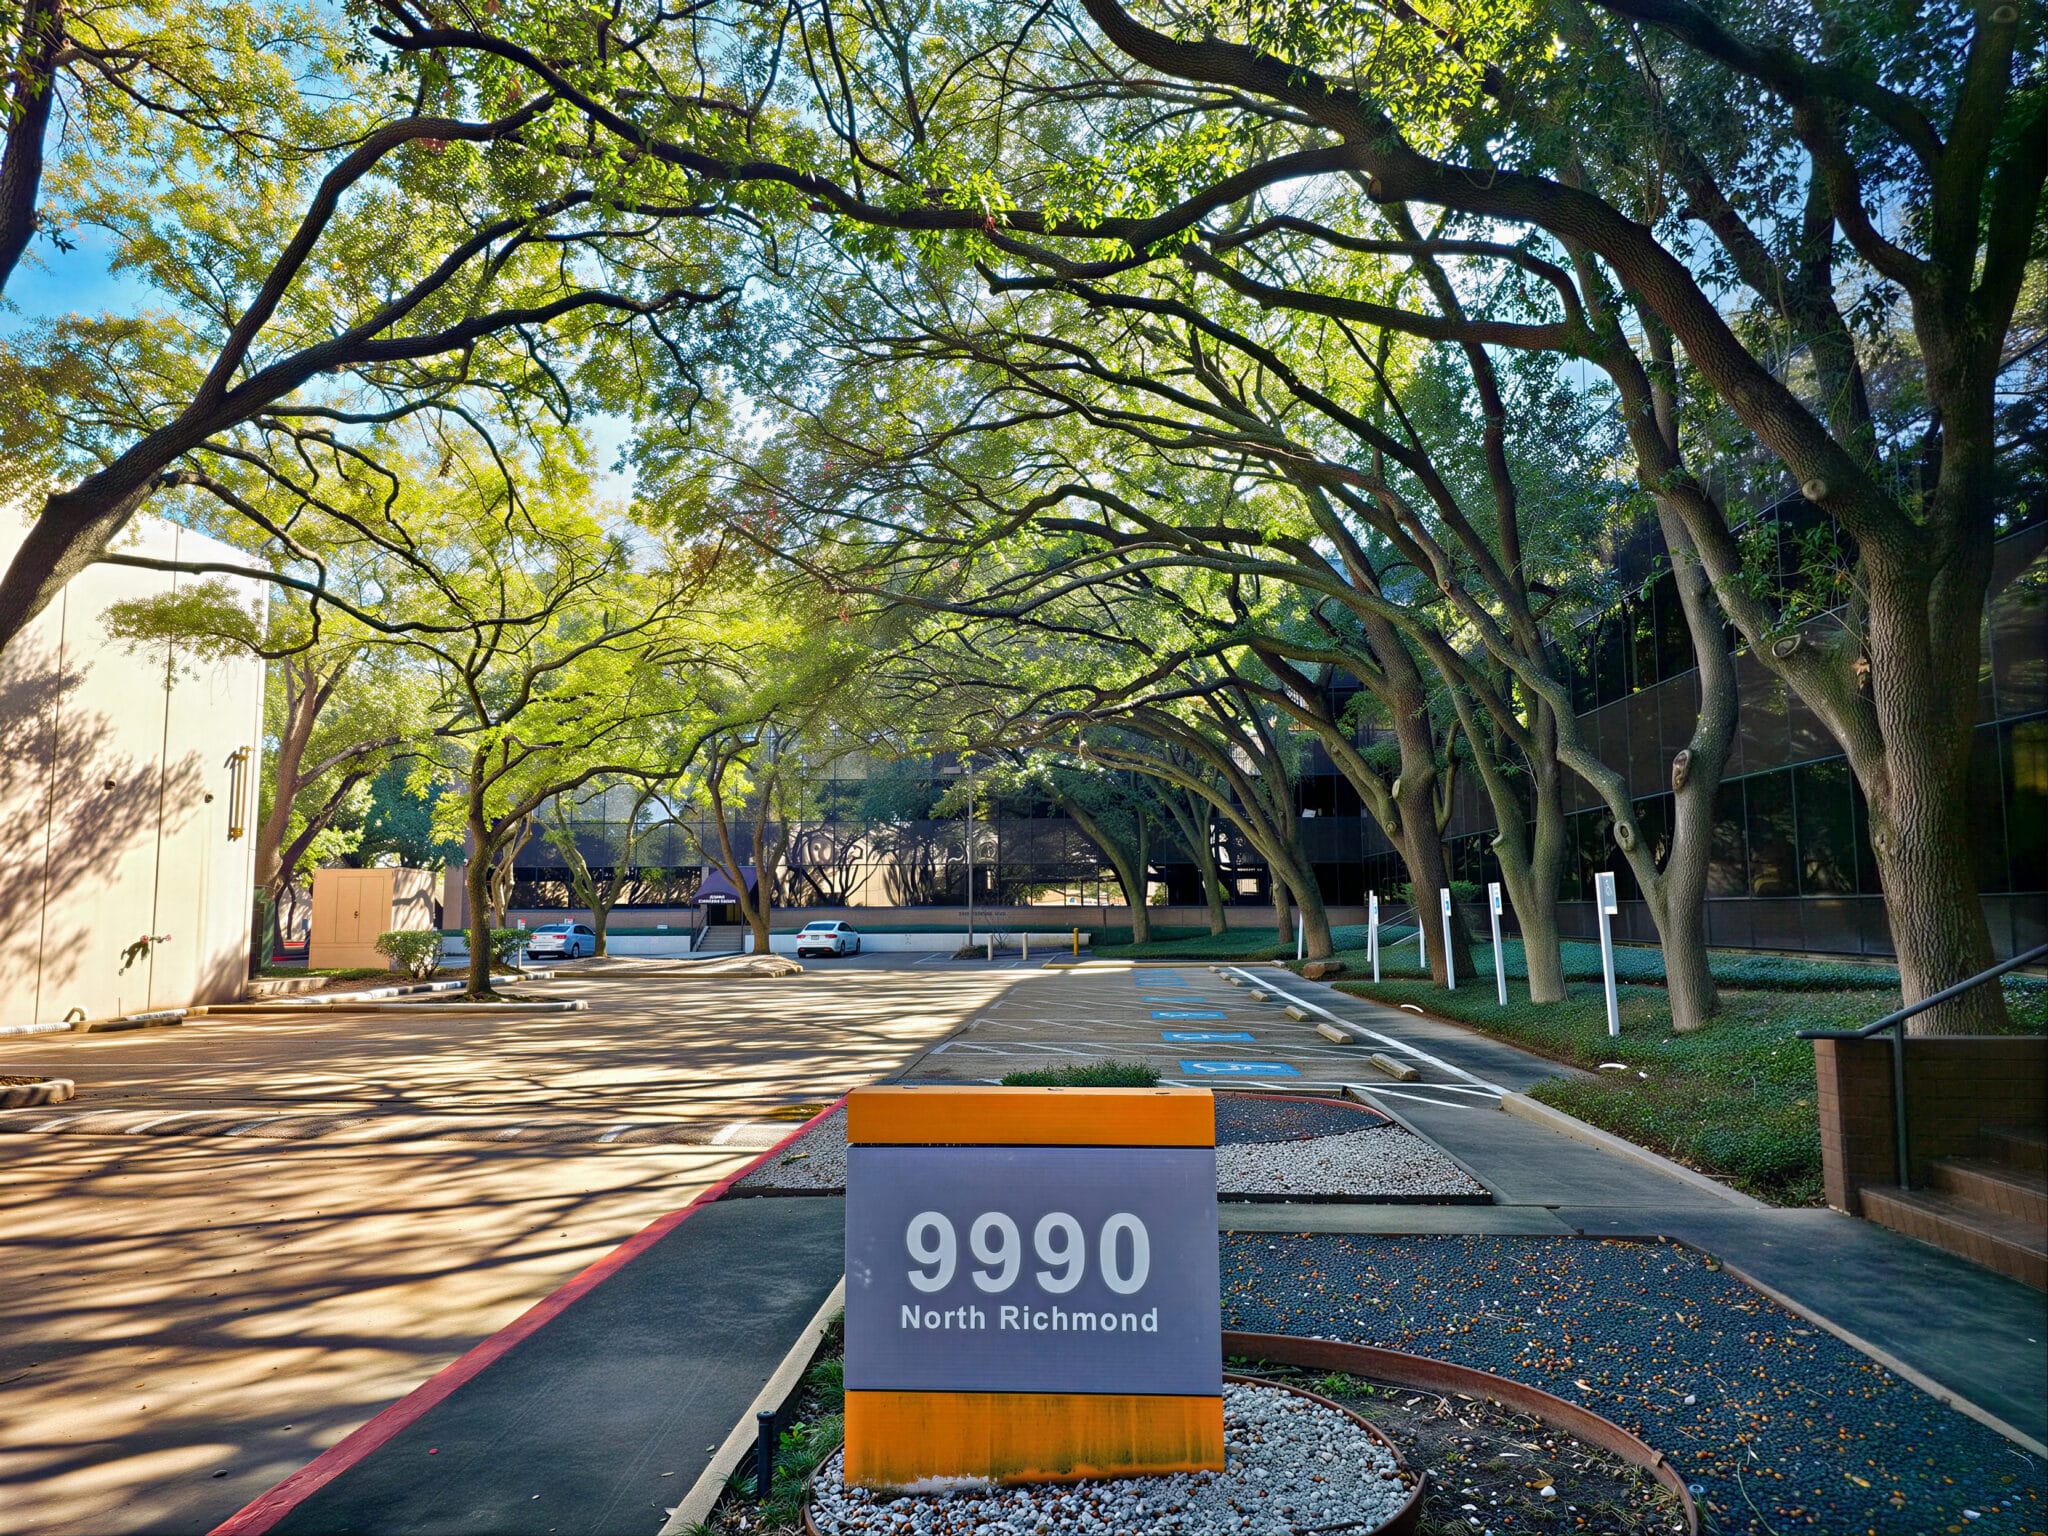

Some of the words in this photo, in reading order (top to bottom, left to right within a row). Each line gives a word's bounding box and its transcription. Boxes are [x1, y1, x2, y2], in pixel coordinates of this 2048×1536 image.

[905, 1211, 1150, 1295] 9990
[901, 1304, 985, 1330] North
[1000, 1305, 1159, 1333] Richmond
